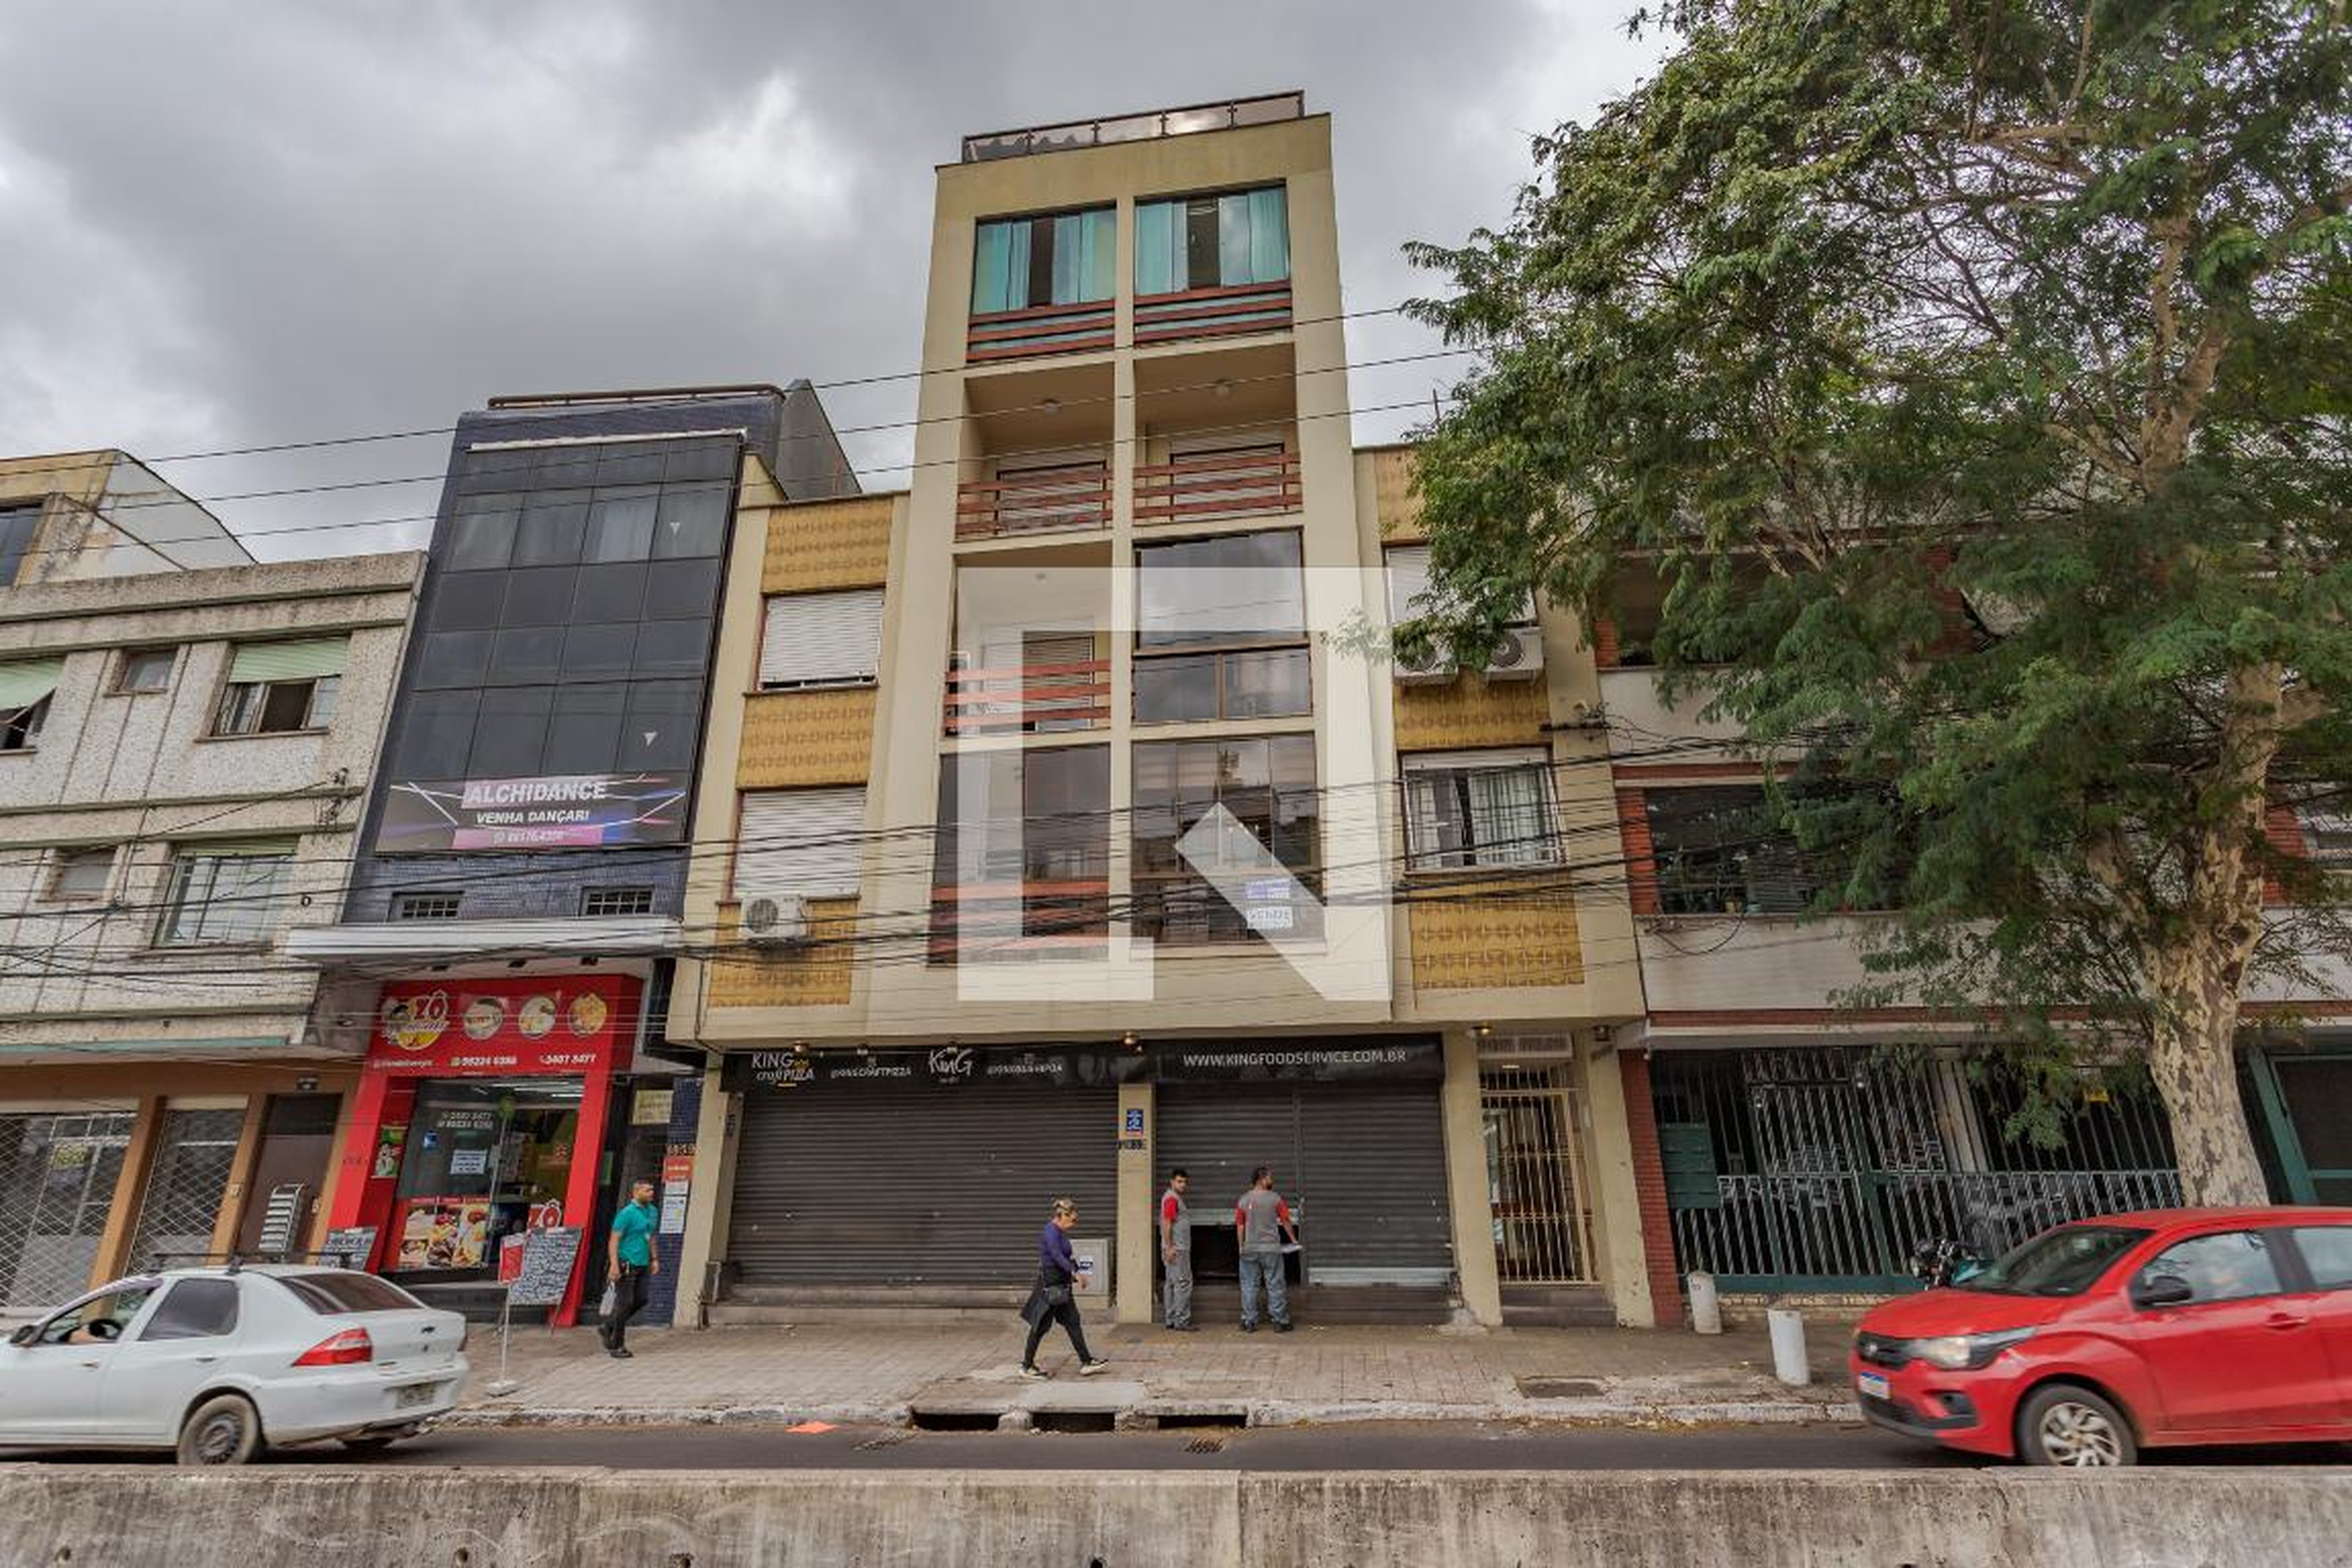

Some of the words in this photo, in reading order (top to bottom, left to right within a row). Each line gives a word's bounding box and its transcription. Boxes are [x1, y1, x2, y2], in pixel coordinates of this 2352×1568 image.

[469, 782, 606, 804] ALCHIDANCE
[477, 812, 524, 824] VENHA
[752, 1052, 794, 1068] KING
[1183, 1050, 1406, 1067] WWW.KINGFOODSERVICE.COM.BR
